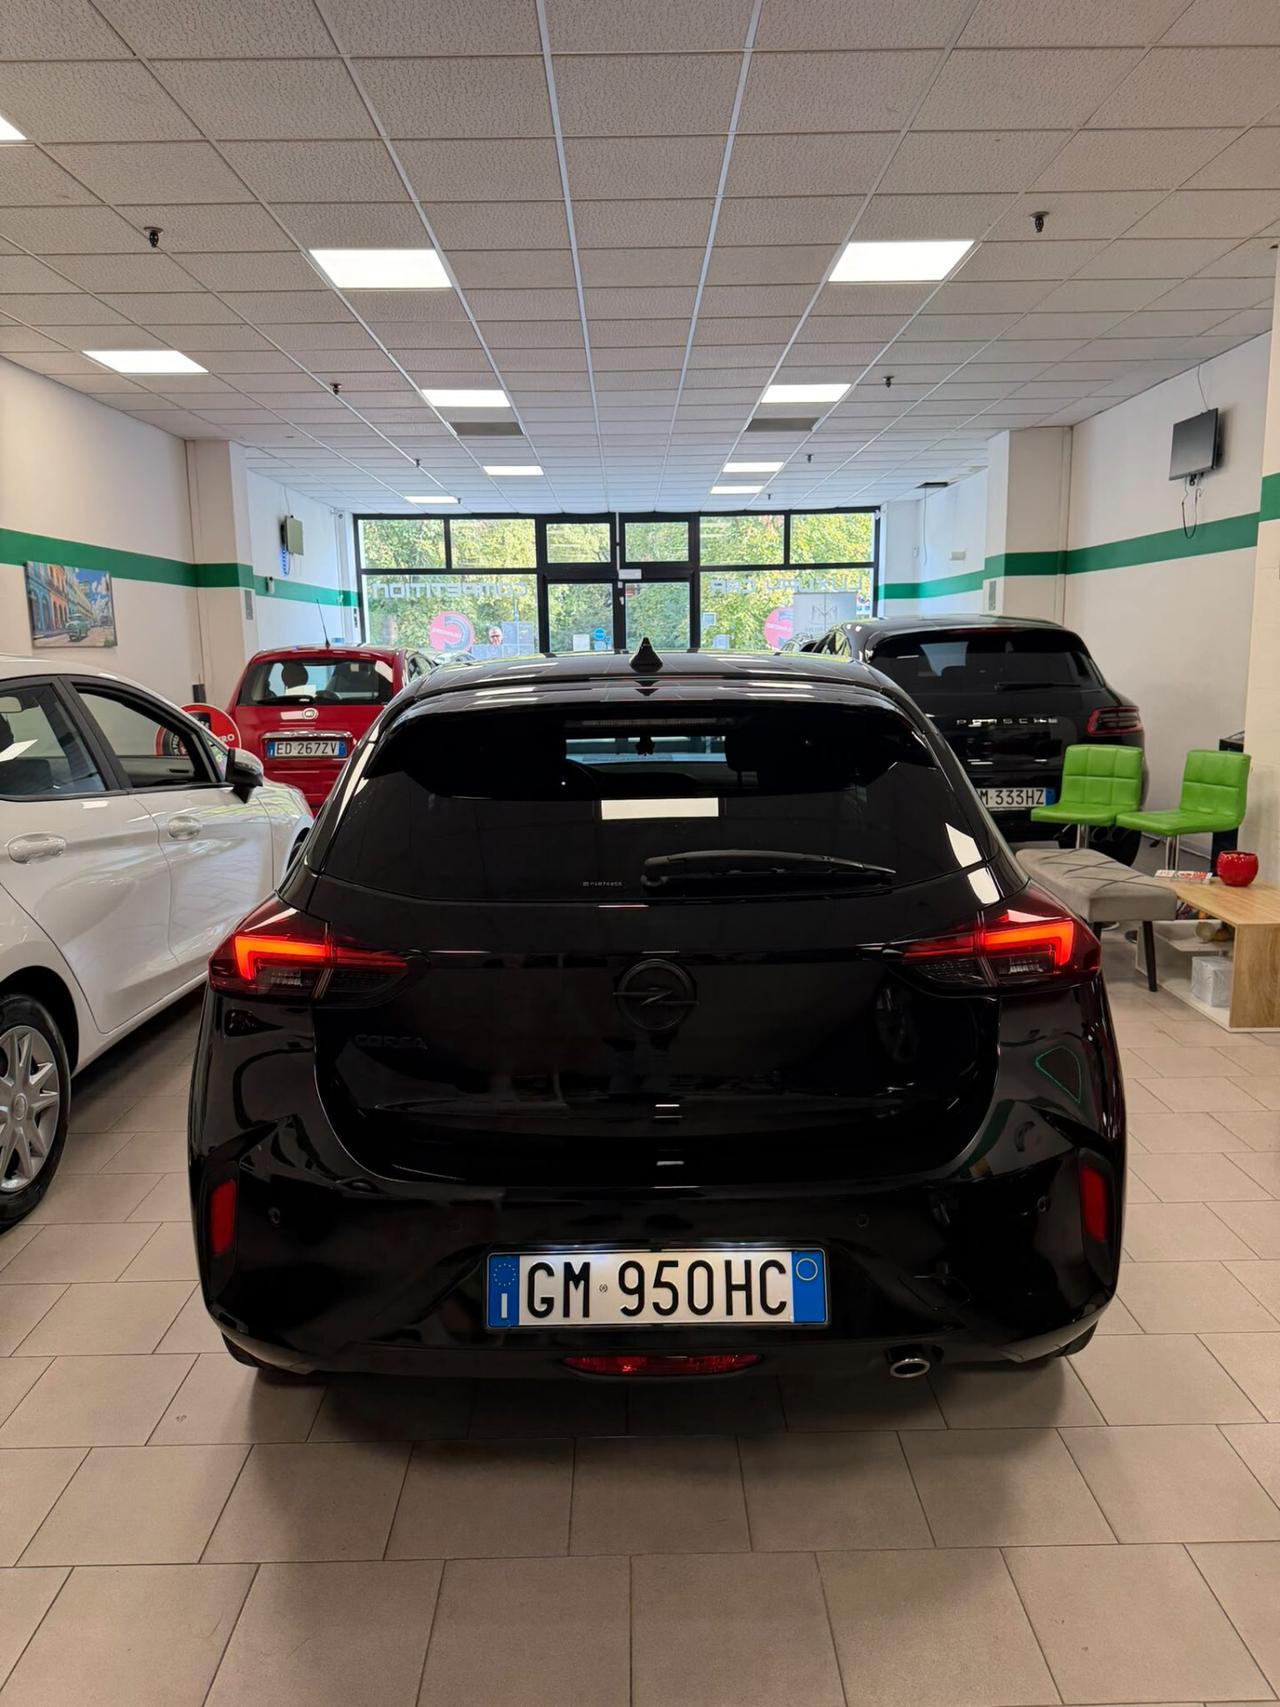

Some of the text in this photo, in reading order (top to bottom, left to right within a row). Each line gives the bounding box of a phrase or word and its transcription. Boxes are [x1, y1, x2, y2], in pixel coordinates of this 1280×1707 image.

[276, 742, 337, 755] ED 267ZV
[995, 789, 1044, 806] 333HZ
[527, 1259, 787, 1319] GM 950HC
